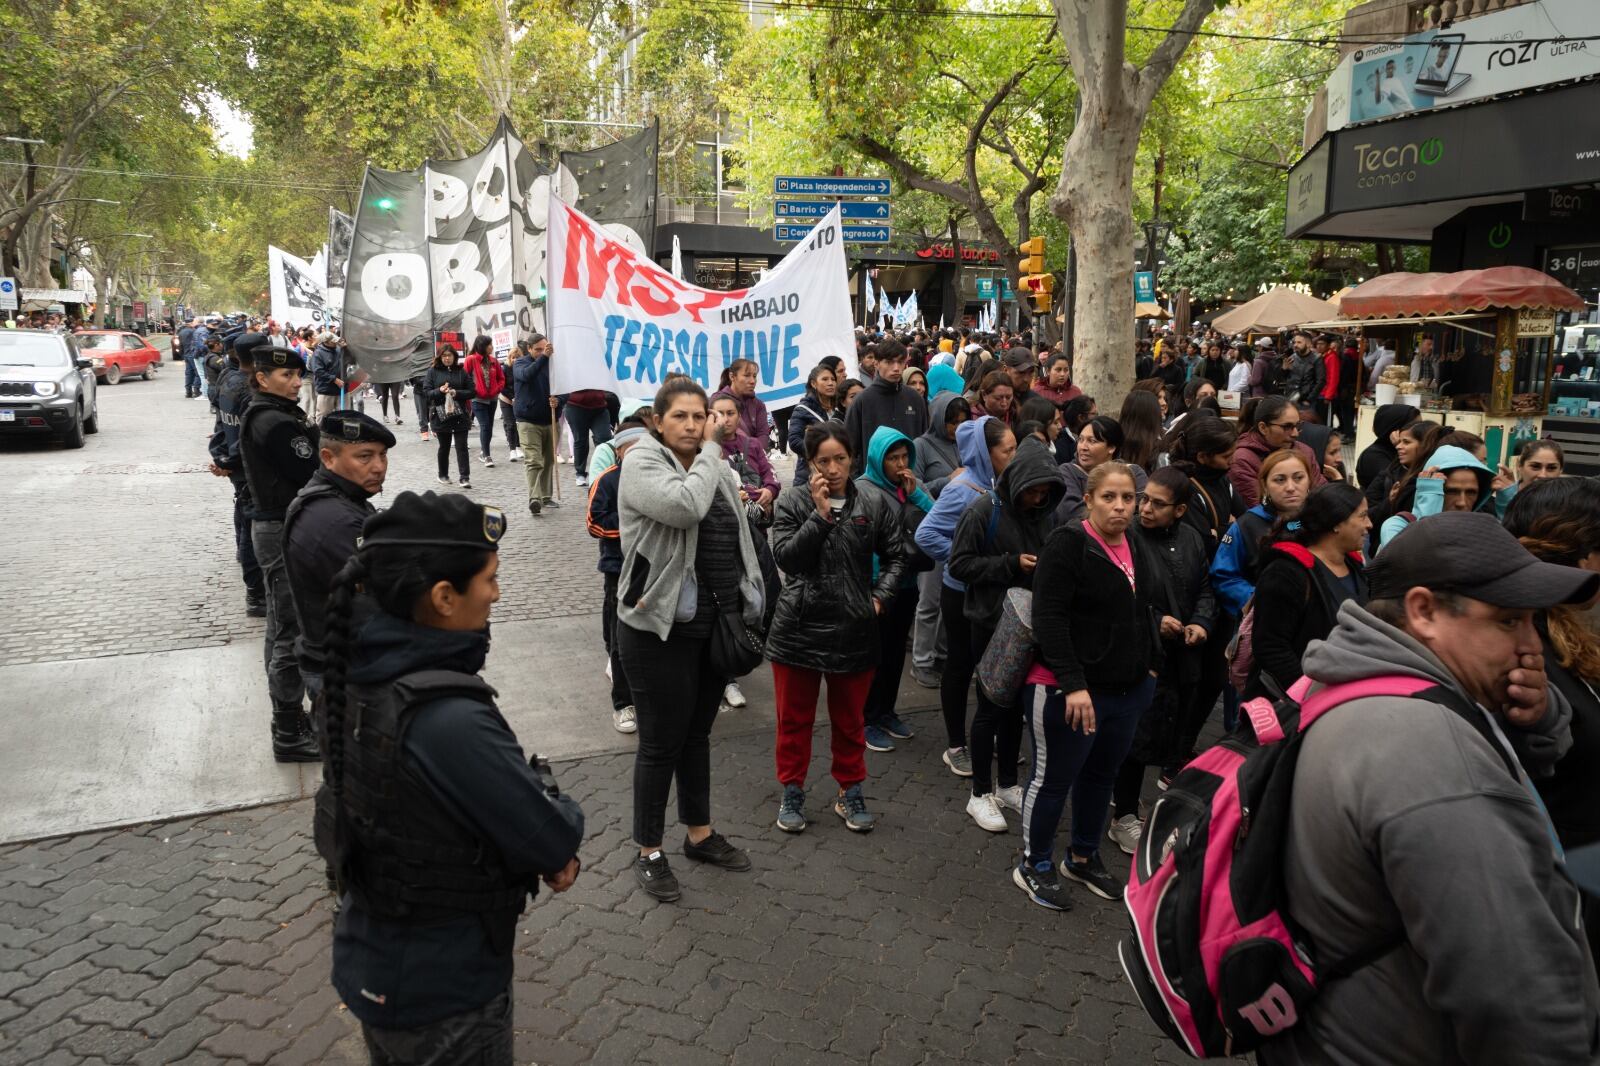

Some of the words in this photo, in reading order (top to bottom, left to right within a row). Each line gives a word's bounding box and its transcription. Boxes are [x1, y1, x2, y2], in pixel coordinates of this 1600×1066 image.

[1487, 40, 1546, 71] razr
[1550, 41, 1587, 57] ULTRA
[790, 181, 814, 190] Plaza
[815, 182, 876, 192] Independencia
[1358, 170, 1417, 190] compro
[789, 205, 817, 214] Barrio
[604, 315, 710, 390] TERESA
[721, 323, 802, 387] VIVE
